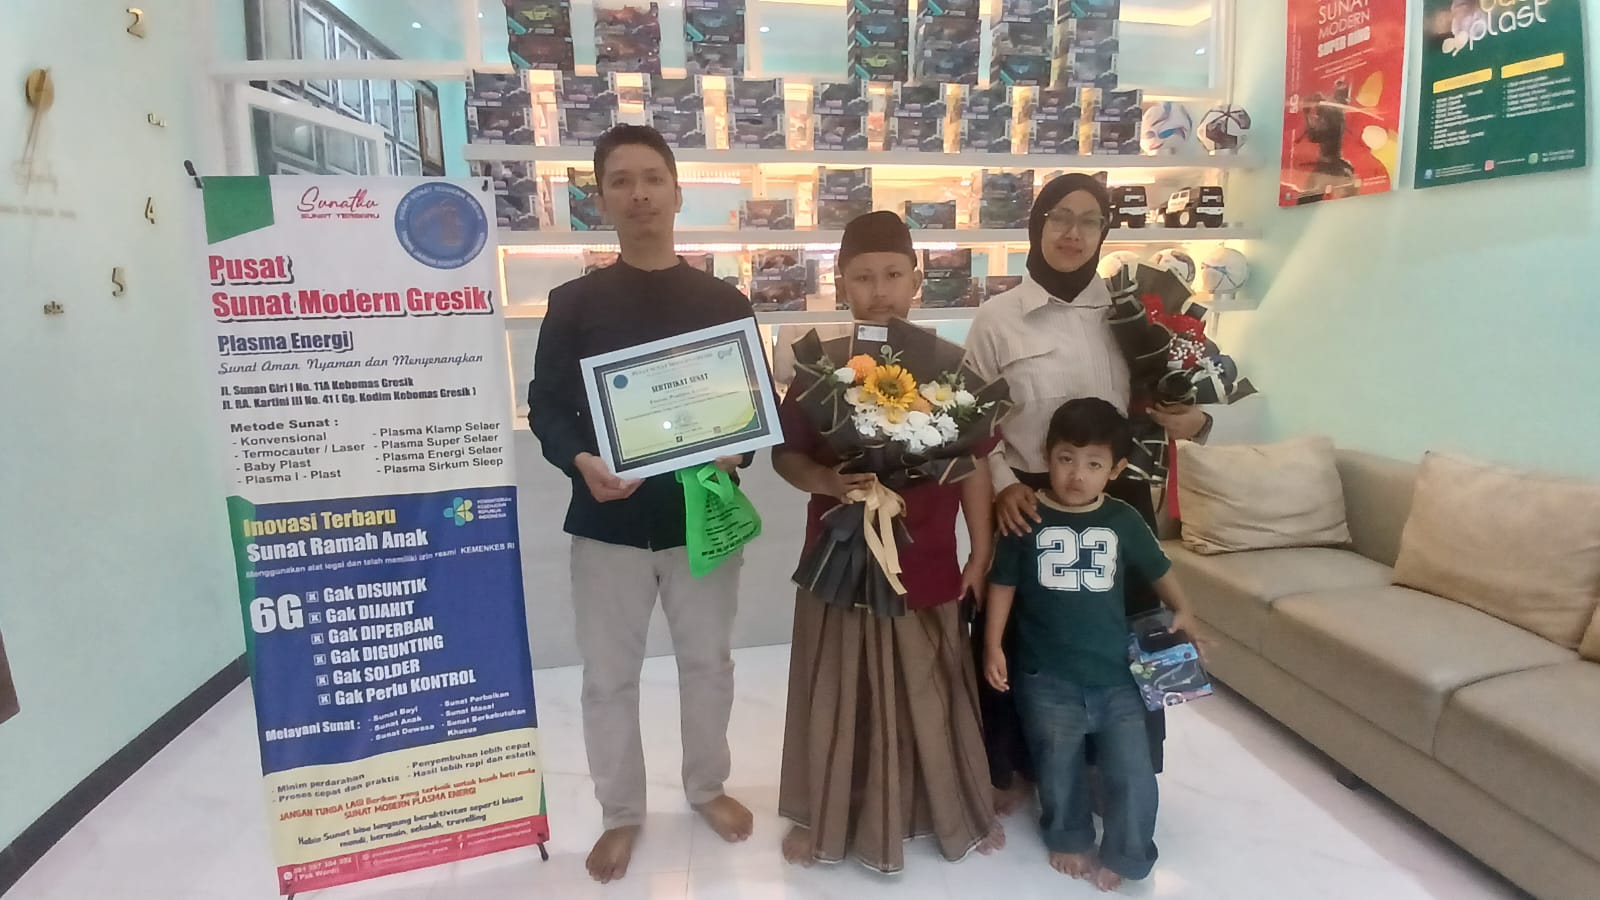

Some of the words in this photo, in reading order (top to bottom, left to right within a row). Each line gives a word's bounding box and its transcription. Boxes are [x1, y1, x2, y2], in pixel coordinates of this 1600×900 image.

[1319, 0, 1369, 24] SUNA
[1319, 8, 1370, 39] MODERN
[208, 254, 290, 283] Pusat
[211, 290, 294, 319] Sunat
[299, 287, 402, 316] Modern
[406, 286, 489, 313] Gresik
[217, 334, 288, 353] Plasma
[290, 330, 350, 351] Energi
[217, 362, 258, 375] Sunat
[306, 358, 361, 372] Nyaman
[365, 356, 388, 368] dan
[392, 353, 483, 368] Menyenangkan
[233, 384, 267, 396] Sunan
[269, 382, 288, 394] Giri
[296, 382, 311, 393] No.
[314, 381, 330, 391] 11A
[332, 379, 379, 391] Kebomas
[381, 377, 414, 388] Gresik
[254, 397, 290, 408] Kartini
[305, 395, 320, 405] No.
[322, 394, 334, 404] 41
[359, 390, 392, 403] Kodim
[393, 388, 439, 401] Kebomas
[440, 387, 471, 398] Gresik
[230, 421, 284, 433] Metode
[289, 418, 330, 430] Sunat
[379, 425, 423, 437] Plasma
[425, 424, 462, 435] Klamp
[240, 431, 327, 446] Konvensional
[381, 438, 424, 449] Plasma
[426, 435, 461, 448] Super
[242, 446, 321, 459] Termocauter
[332, 442, 365, 453] Laser
[382, 450, 425, 462] Plasma
[427, 447, 465, 459] Energi
[244, 460, 276, 473] Baby
[280, 458, 311, 470] Plast
[245, 473, 292, 485] Plasma
[310, 468, 342, 480] Plast
[383, 463, 426, 475] Plasma
[428, 460, 470, 472] Sirkum
[472, 457, 504, 468] Sleep
[243, 512, 318, 537] Inovasi
[320, 508, 397, 530] Terbaru
[246, 540, 308, 563] Sunat
[310, 532, 379, 556] Ramah
[382, 528, 429, 549] Anak
[246, 565, 306, 578] Menggunakan
[307, 563, 323, 571] alat
[325, 561, 345, 571] legal
[346, 558, 361, 568] dan
[364, 557, 384, 566] telah
[385, 554, 418, 565] memiliki
[435, 549, 457, 558] resmi
[460, 543, 505, 554] KEMENKES
[507, 542, 515, 550] RI
[1036, 526, 1119, 592] 23
[323, 585, 355, 603] Gak
[356, 577, 428, 599] DISUNTIK
[249, 593, 304, 634] 6G
[325, 606, 357, 624] Gak
[359, 600, 415, 620] DIJAHIT
[328, 626, 359, 645] Gak
[361, 616, 434, 641] DIPERBAN
[330, 647, 361, 665] Gak
[362, 634, 444, 661] DIGUNTING
[333, 667, 362, 685] Gak
[364, 658, 421, 681] SOLDER
[335, 688, 364, 706] Gak
[366, 681, 408, 703] Perlu
[410, 669, 477, 693] KONTROL
[444, 696, 468, 707] Sunat
[470, 691, 510, 704] Perbaikan
[373, 710, 398, 722] Sunat
[400, 705, 418, 715] Bayi
[374, 720, 399, 732] Sunat
[401, 715, 422, 725] Anak
[445, 707, 469, 717] Sunat
[446, 717, 470, 727] Sunat
[471, 708, 526, 723] Berkebutuhan
[265, 722, 321, 742] Melayani
[322, 719, 356, 733] Sunat
[375, 729, 400, 741] Sunat
[402, 724, 435, 735] Dewasa
[447, 726, 477, 737] Khusus
[412, 751, 478, 769] Penyembuhan
[480, 745, 503, 757] lebih
[505, 741, 531, 752] cepat
[413, 767, 438, 778] Hasil
[440, 762, 463, 773] lebih
[465, 759, 484, 771] rapi
[486, 755, 504, 764] dan
[505, 750, 536, 761] estetik
[277, 781, 308, 793] Minim
[310, 773, 365, 790] perdarahan
[279, 791, 313, 803] Proses
[314, 788, 342, 800] cepat
[344, 783, 363, 793] dan
[365, 775, 400, 788] praktis
[280, 808, 313, 821] JANGAN
[400, 788, 420, 800] yang
[453, 778, 477, 789] untuk
[344, 806, 372, 819] SUNAT
[374, 797, 411, 813] MODERN
[412, 792, 447, 806] PLASMA
[448, 786, 477, 799] ENERGI
[323, 829, 351, 841] Sunat
[373, 816, 412, 830] langsung
[413, 806, 468, 821] beraktivitas
[469, 799, 500, 812] seperti
[446, 813, 487, 827] travelling
